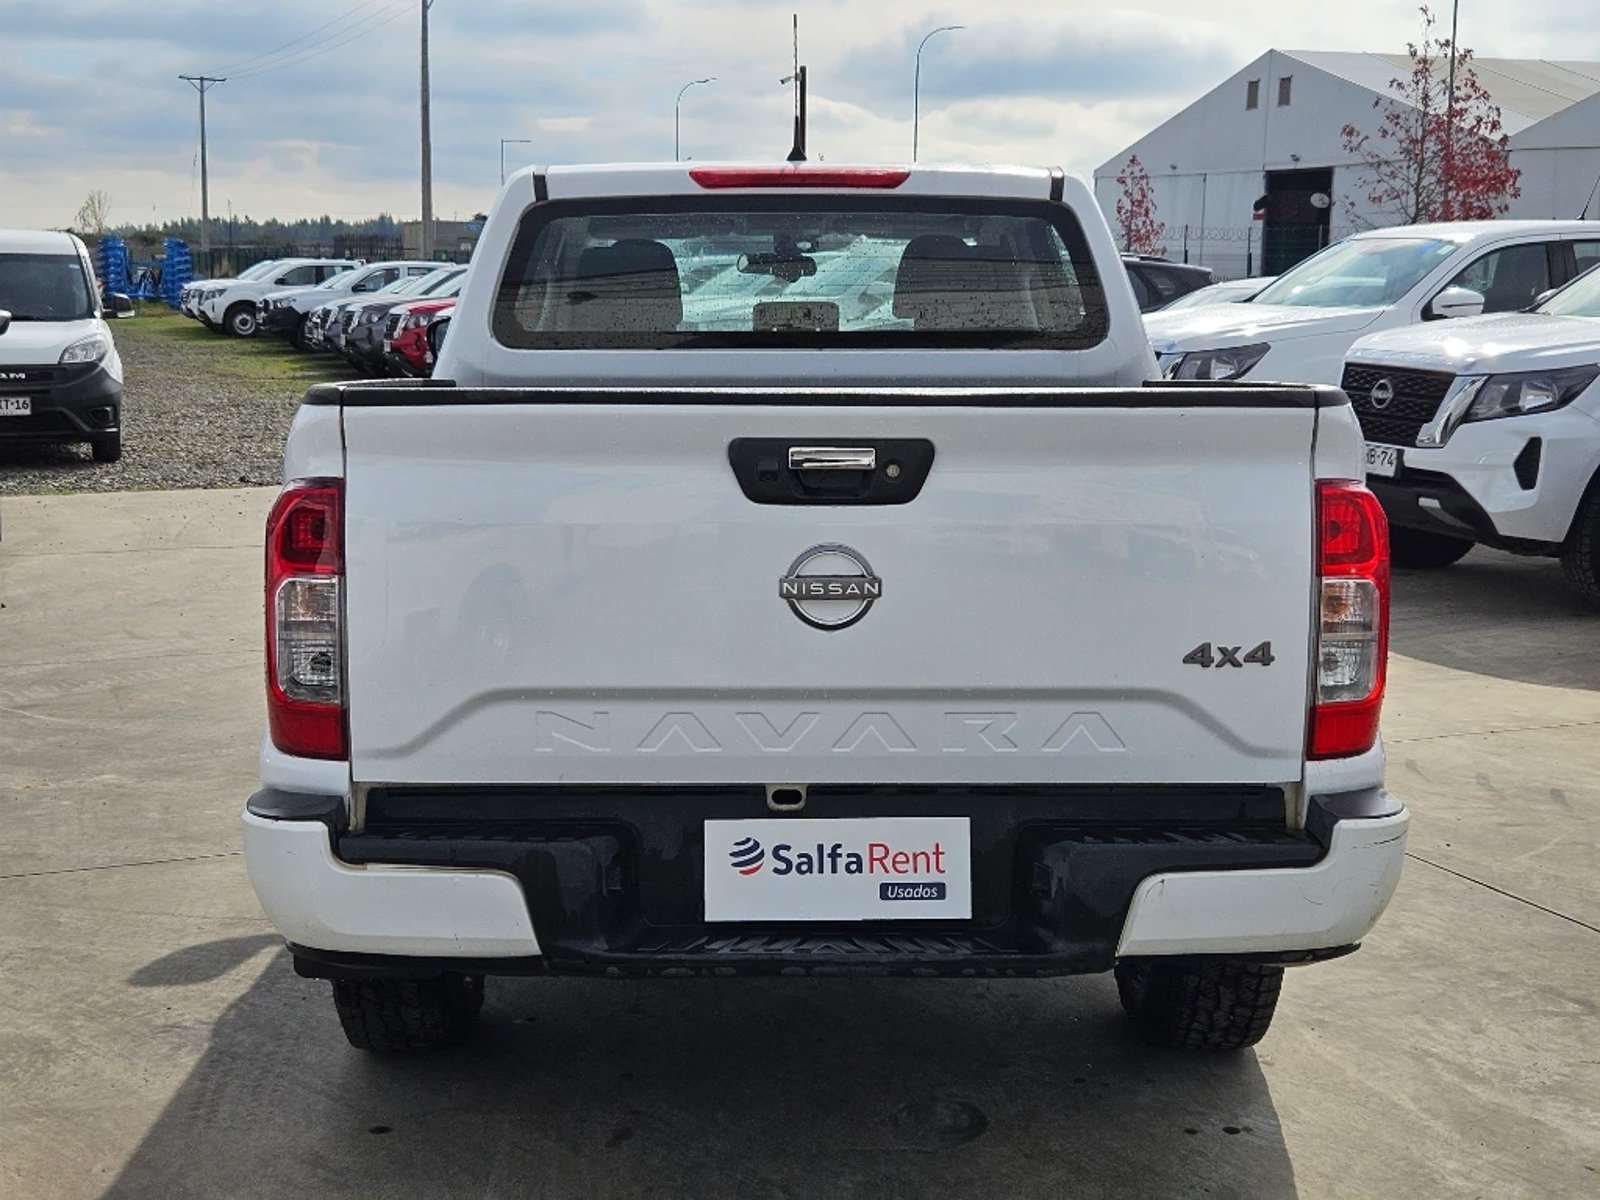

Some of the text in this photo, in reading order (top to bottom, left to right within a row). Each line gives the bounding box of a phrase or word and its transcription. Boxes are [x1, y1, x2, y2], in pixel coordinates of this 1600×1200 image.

[782, 582, 879, 595] NISSAN
[1182, 640, 1276, 668] 4x4
[534, 711, 1127, 754] NAVARA
[771, 842, 946, 876] SalfaRent
[887, 884, 938, 899] Usados
